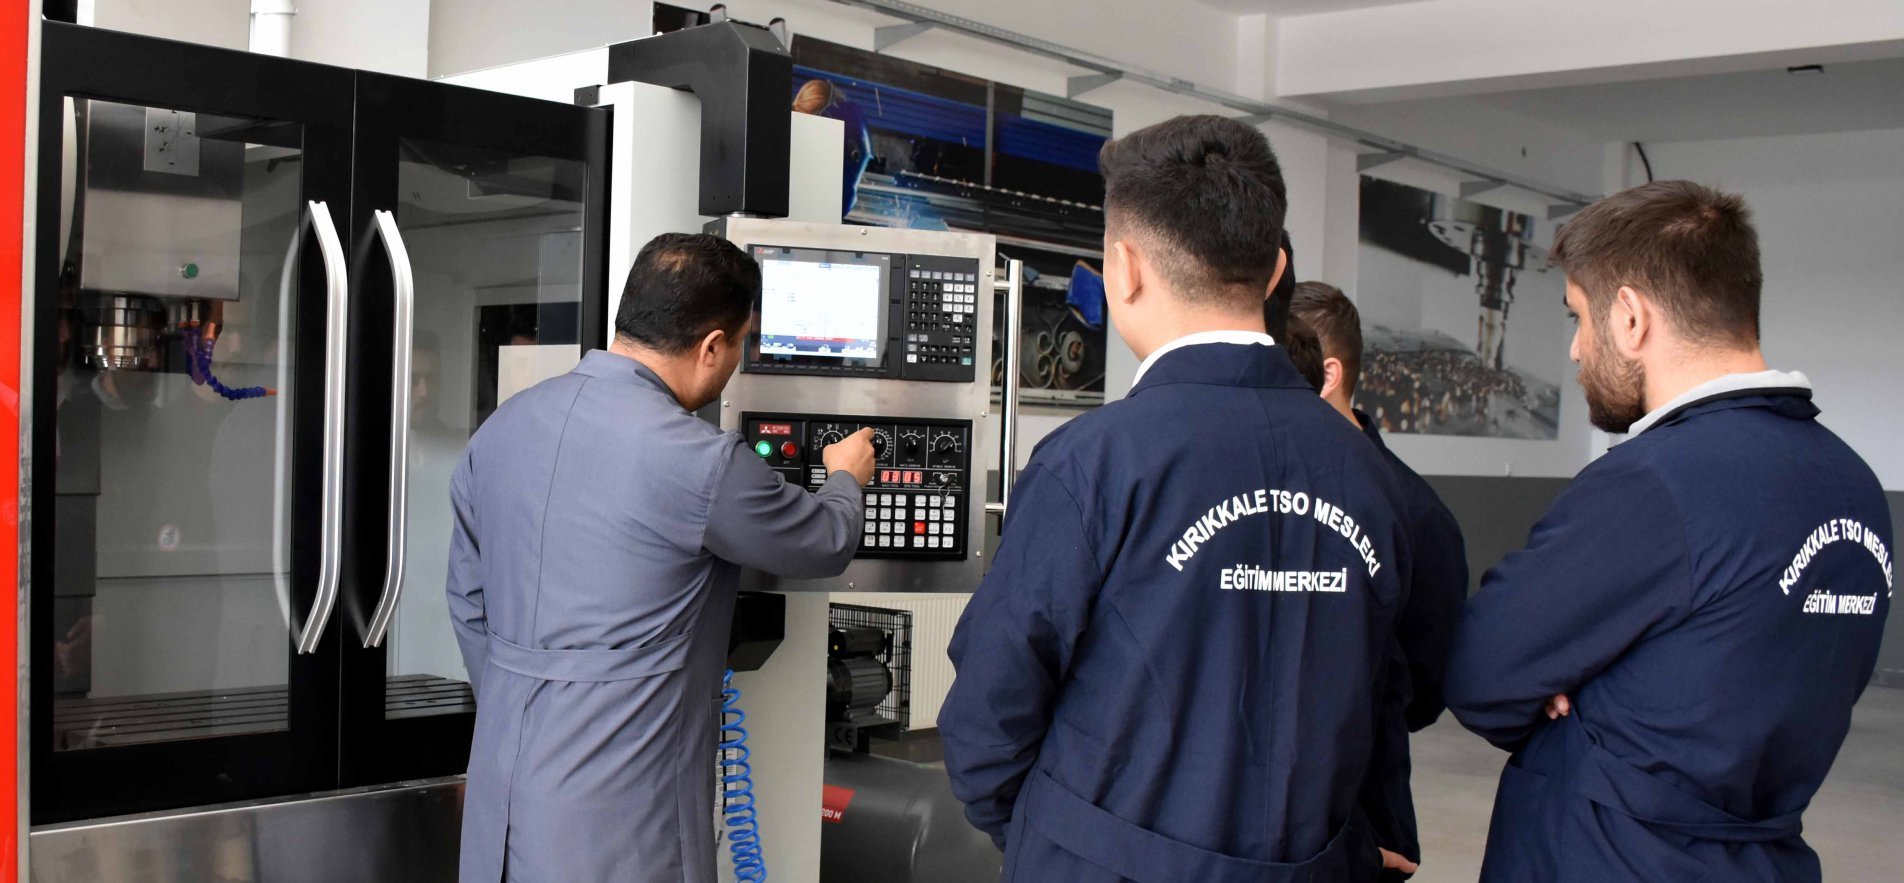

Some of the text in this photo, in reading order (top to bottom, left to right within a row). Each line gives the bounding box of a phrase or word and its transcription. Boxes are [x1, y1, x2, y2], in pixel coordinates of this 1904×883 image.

[1165, 489, 1268, 572] KIRIKKALE
[1269, 489, 1309, 516] TSO
[1778, 518, 1840, 596] KIRIKKALE
[1839, 518, 1862, 543] TSO
[1220, 563, 1272, 591] EĞİTİM
[1837, 591, 1878, 615] MERKEZİ
[833, 810, 842, 820] M
